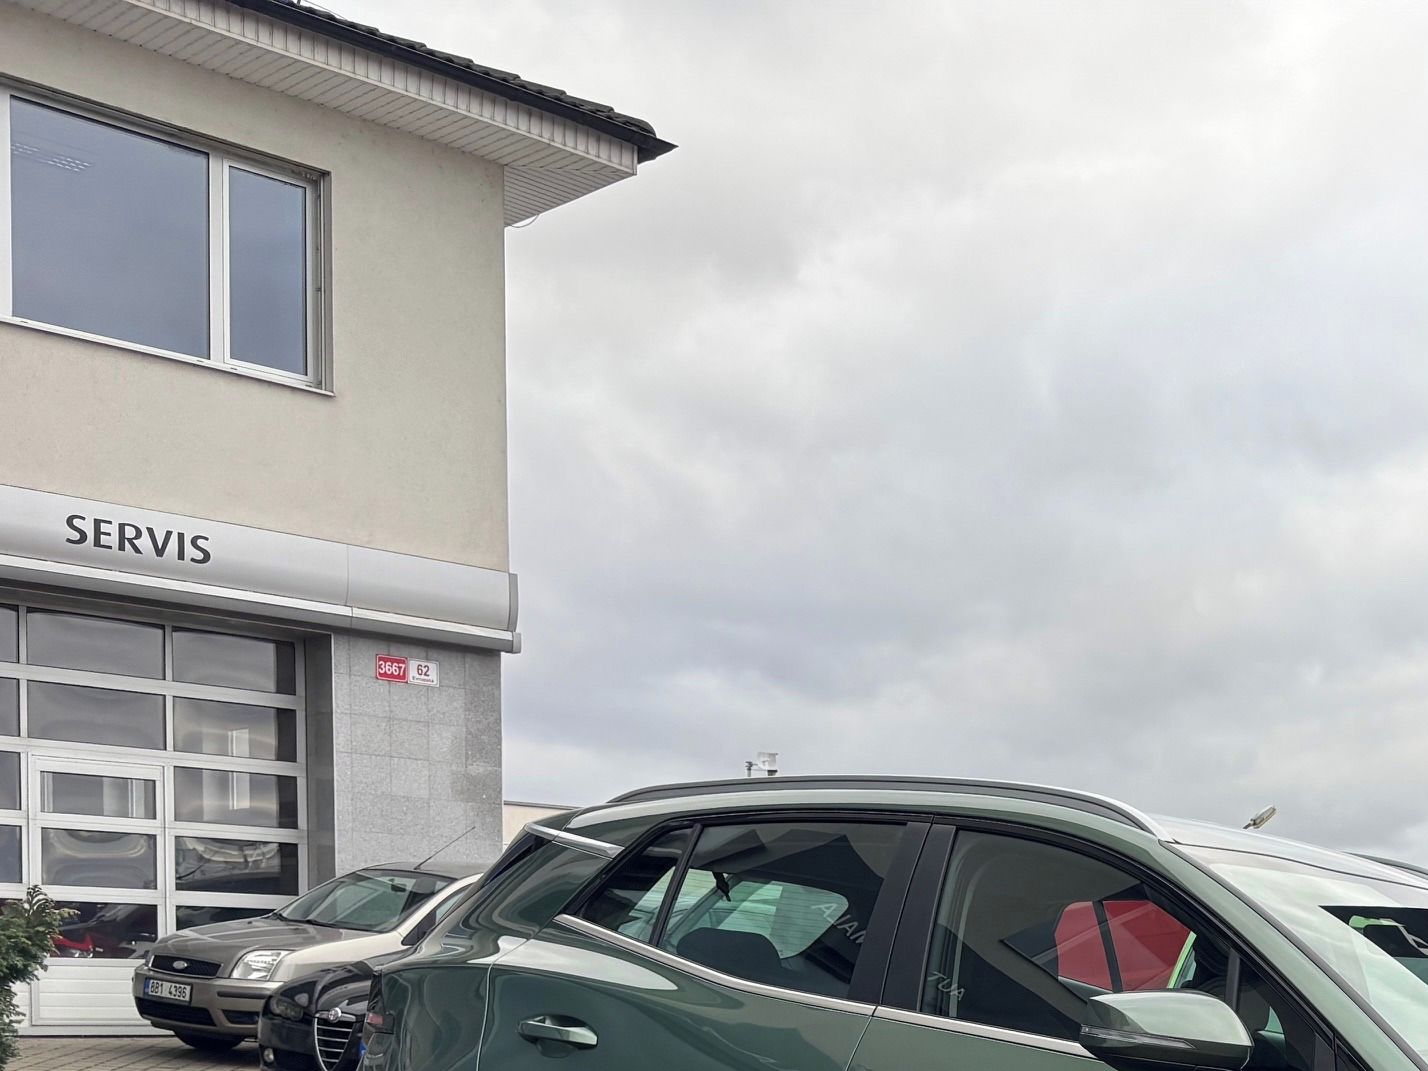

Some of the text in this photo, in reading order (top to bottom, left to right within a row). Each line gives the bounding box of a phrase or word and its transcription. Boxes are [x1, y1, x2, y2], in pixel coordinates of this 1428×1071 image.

[65, 514, 212, 565] SERVIS
[378, 660, 406, 677] 3667
[416, 664, 430, 677] 62
